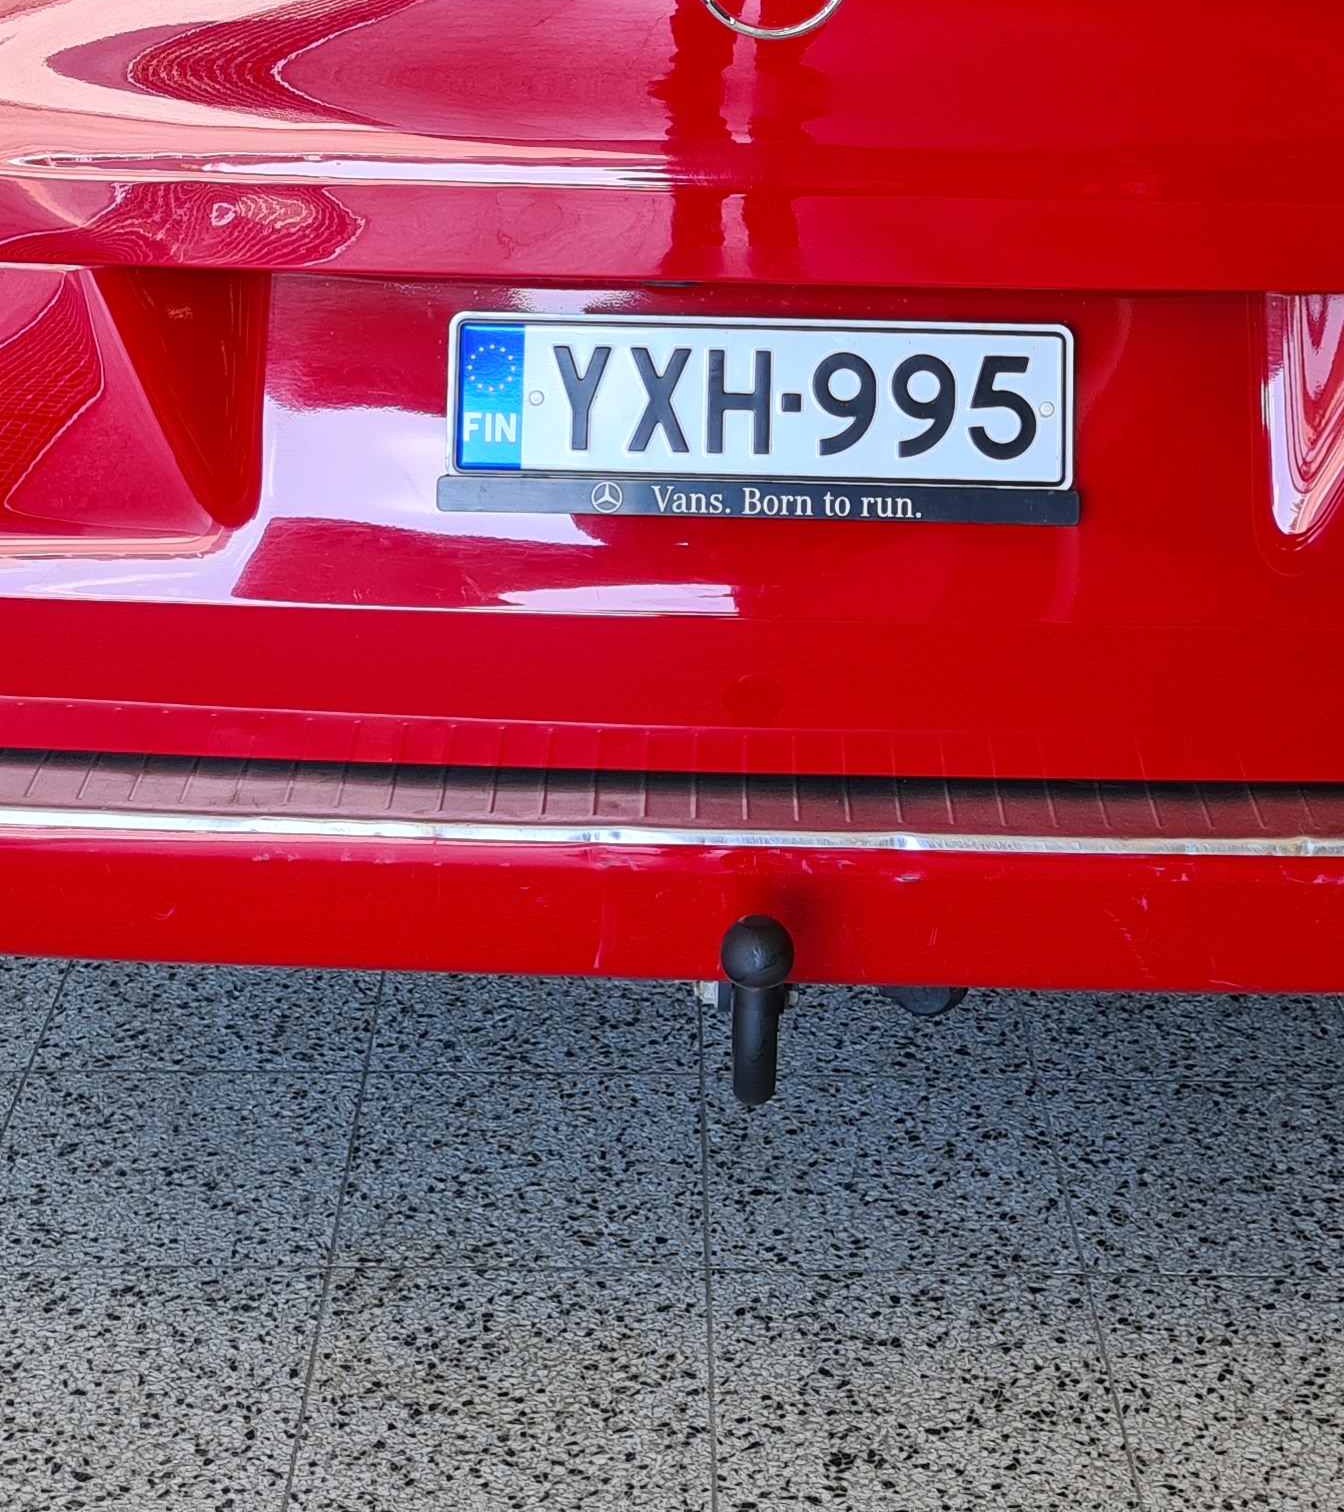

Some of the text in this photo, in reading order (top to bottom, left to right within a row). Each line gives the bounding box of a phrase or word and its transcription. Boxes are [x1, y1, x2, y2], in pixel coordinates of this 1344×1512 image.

[552, 344, 1038, 461] YXH-995
[463, 411, 517, 443] FIN
[650, 484, 924, 520] Vans. Born to run.
